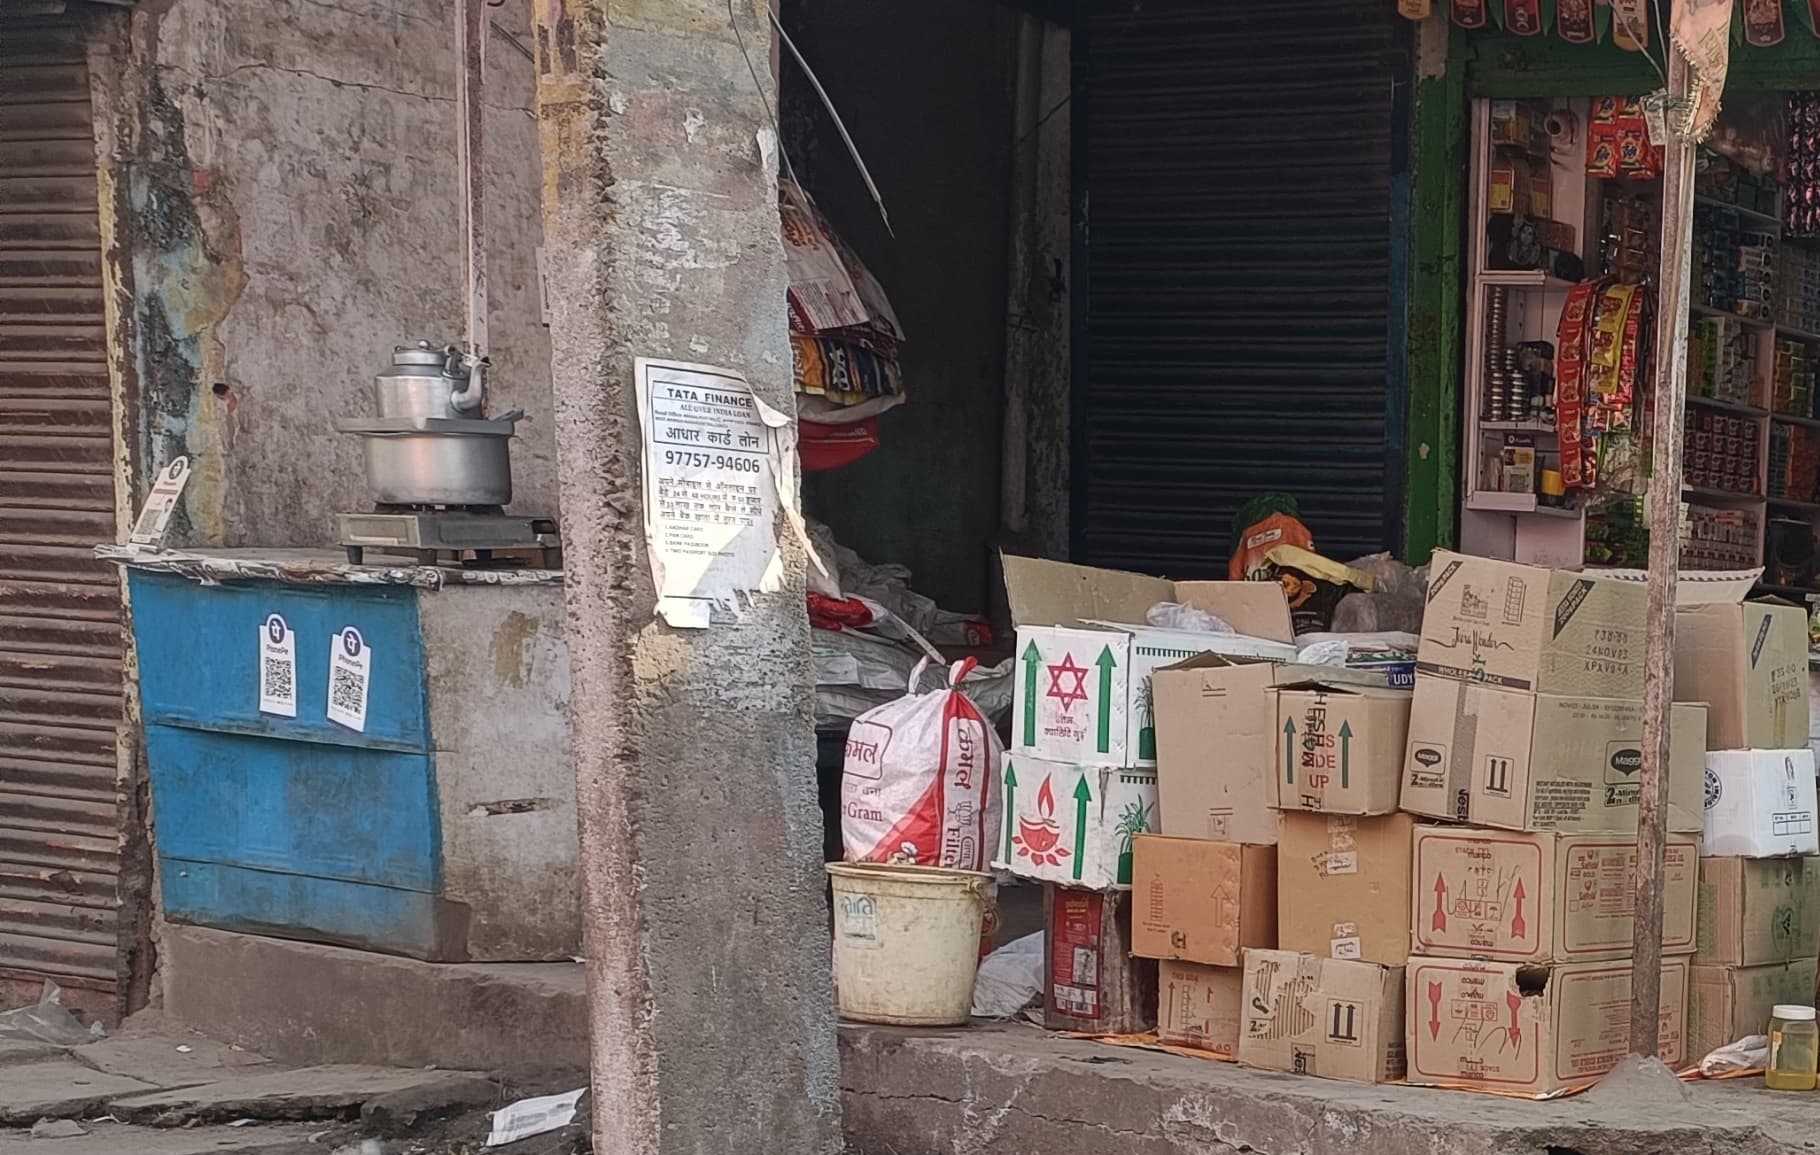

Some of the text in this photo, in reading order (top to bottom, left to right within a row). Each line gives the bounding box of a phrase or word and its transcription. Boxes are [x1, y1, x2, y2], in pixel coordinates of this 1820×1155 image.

[667, 388, 753, 407] TATA FINANCE
[666, 427, 700, 442] आधार
[707, 429, 732, 446] कार्ड
[665, 450, 760, 473] 97757-94606
[1615, 755, 1641, 767] Magg
[1309, 774, 1330, 789] UP
[847, 802, 883, 822] Gram
